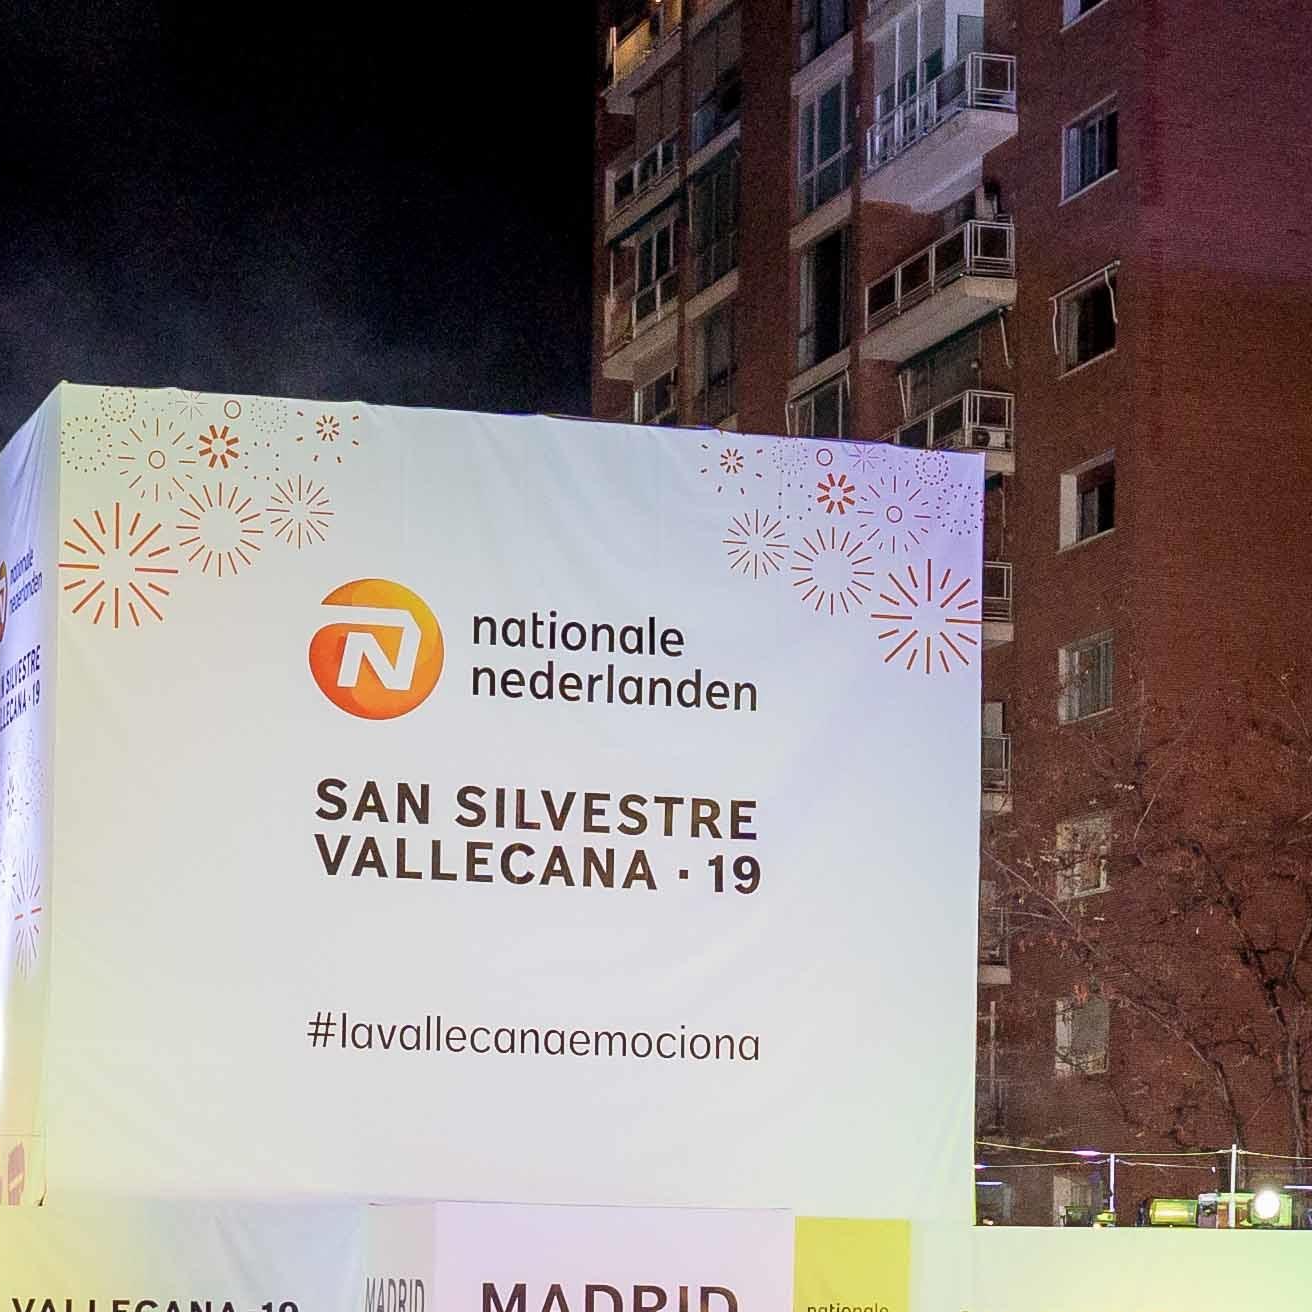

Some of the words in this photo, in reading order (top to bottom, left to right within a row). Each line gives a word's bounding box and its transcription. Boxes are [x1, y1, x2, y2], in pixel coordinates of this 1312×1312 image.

[472, 610, 686, 658] nationale
[471, 660, 758, 712] nederlanden
[315, 779, 431, 826] SAN
[454, 786, 758, 842] SILVESTRE
[314, 833, 658, 891] VALLECANA
[707, 854, 762, 895] 19
[306, 1010, 761, 1062] #lavallecanaemociona
